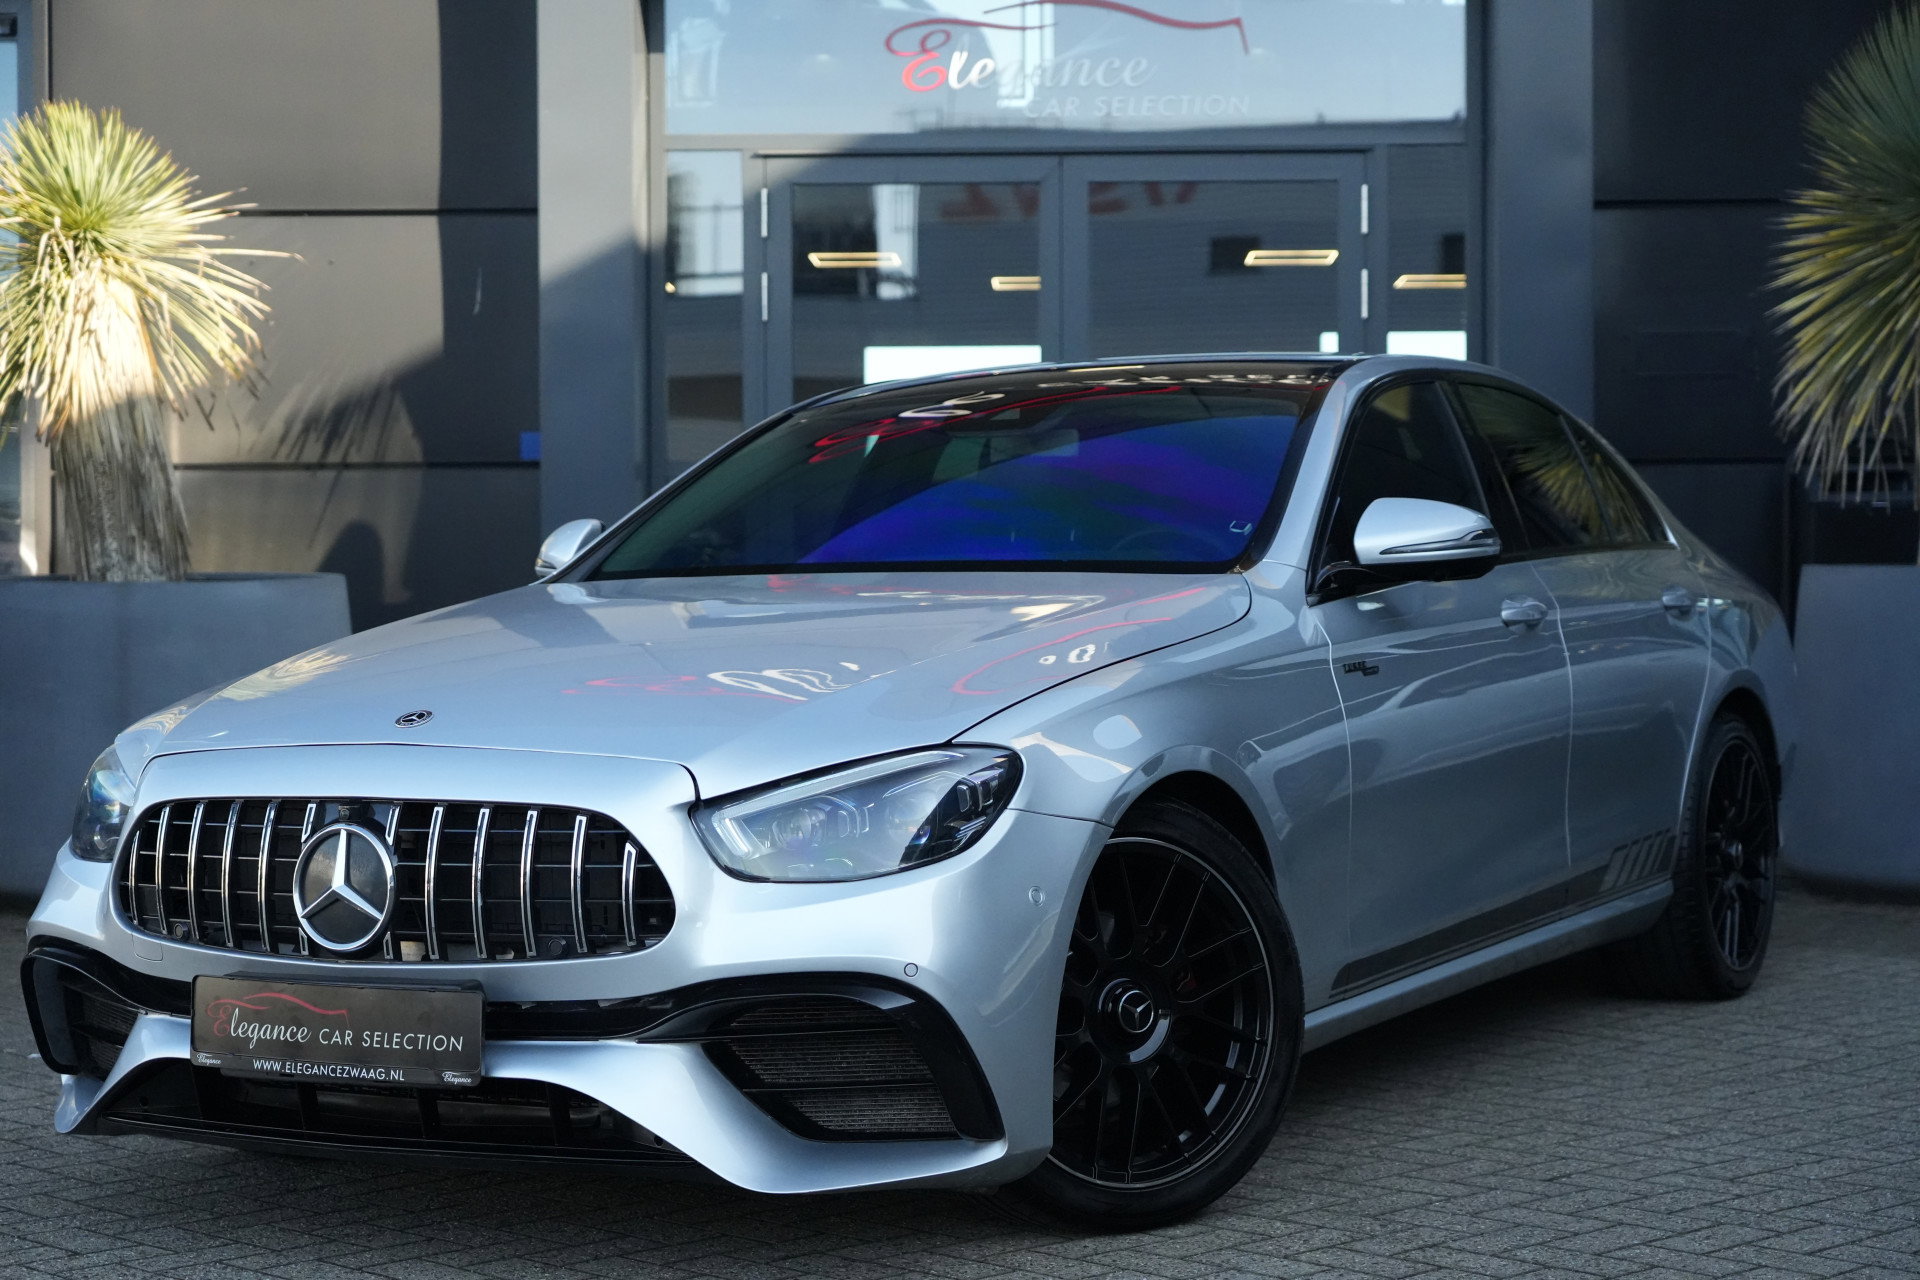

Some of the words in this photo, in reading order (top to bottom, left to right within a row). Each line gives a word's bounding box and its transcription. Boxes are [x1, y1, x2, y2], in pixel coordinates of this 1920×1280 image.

[885, 19, 1158, 104] Elegance
[1022, 97, 1079, 119] CAR
[1097, 94, 1250, 118] SELECTION
[206, 998, 312, 1049] Elegance
[318, 1028, 354, 1046] CAR
[361, 1030, 464, 1052] SELECTION
[252, 1058, 405, 1082] WWW.ELEGANCEZWAAG.NL
